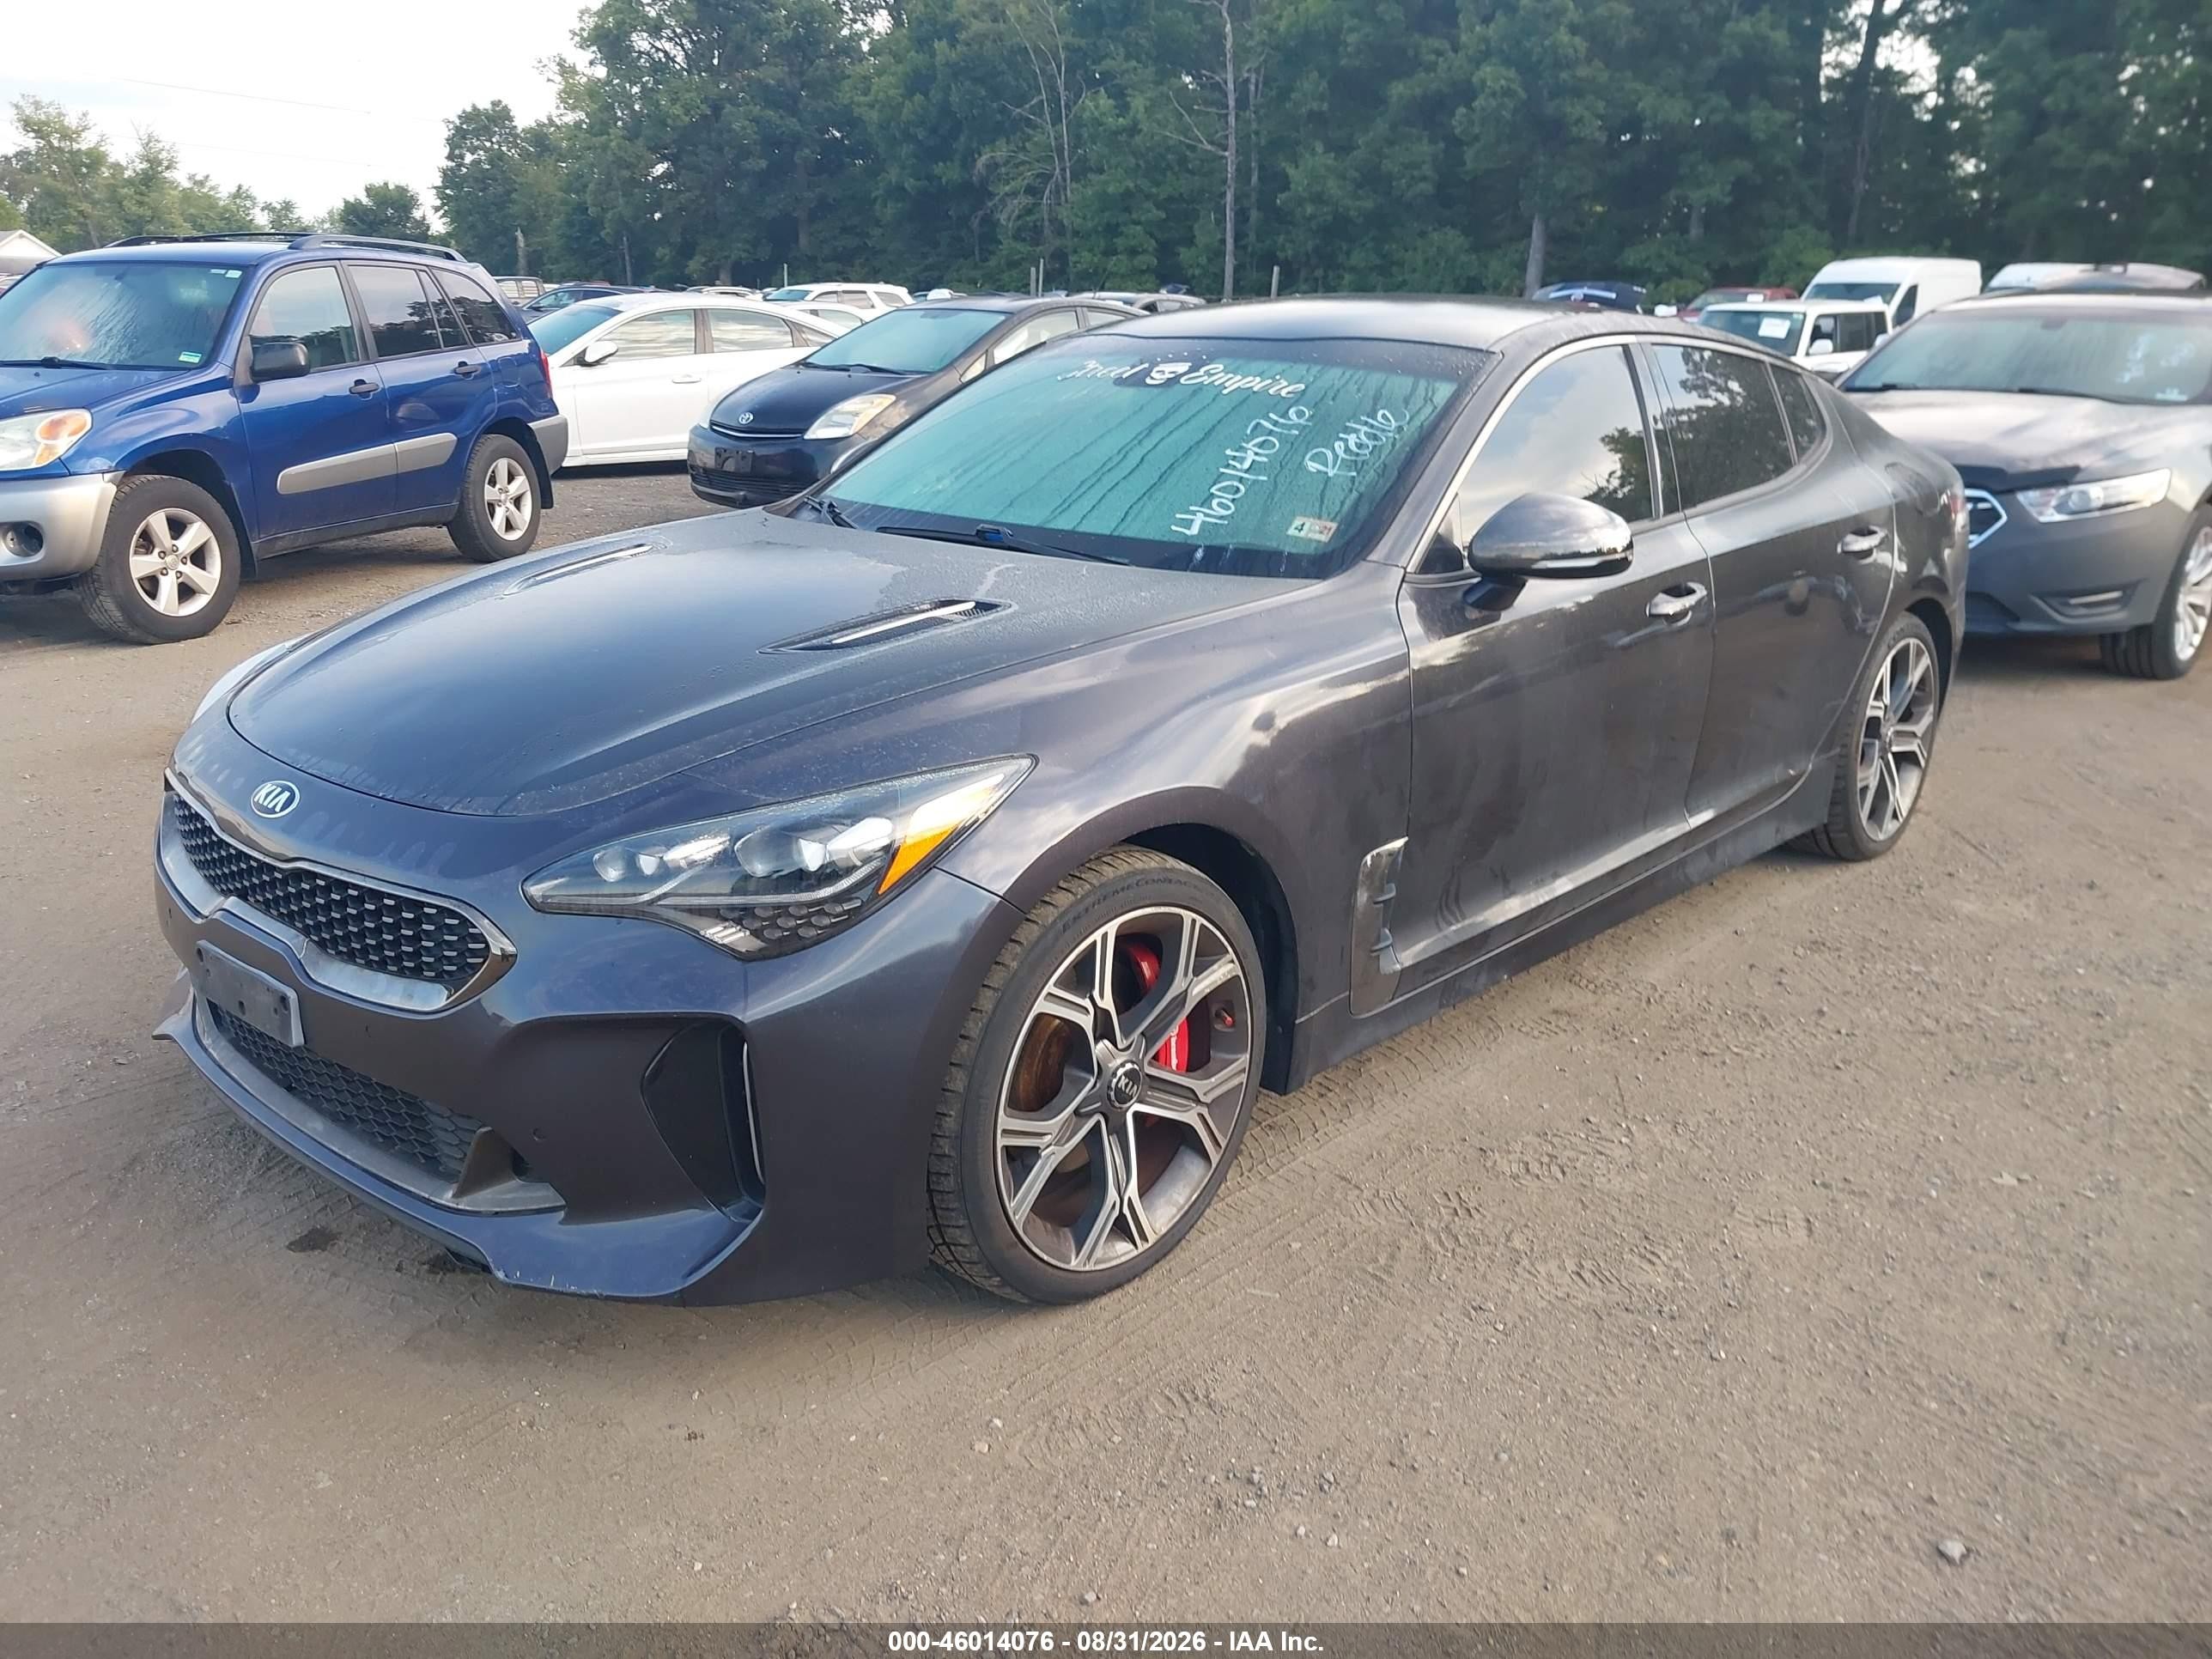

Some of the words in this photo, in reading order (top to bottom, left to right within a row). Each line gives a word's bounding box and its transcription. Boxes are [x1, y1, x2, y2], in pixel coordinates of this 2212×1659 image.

[1180, 364, 1305, 398] Empire
[1170, 405, 1312, 536] 46014076
[1293, 521, 1305, 532] 4
[252, 782, 291, 813] KIA
[1117, 1074, 1138, 1097] KIA
